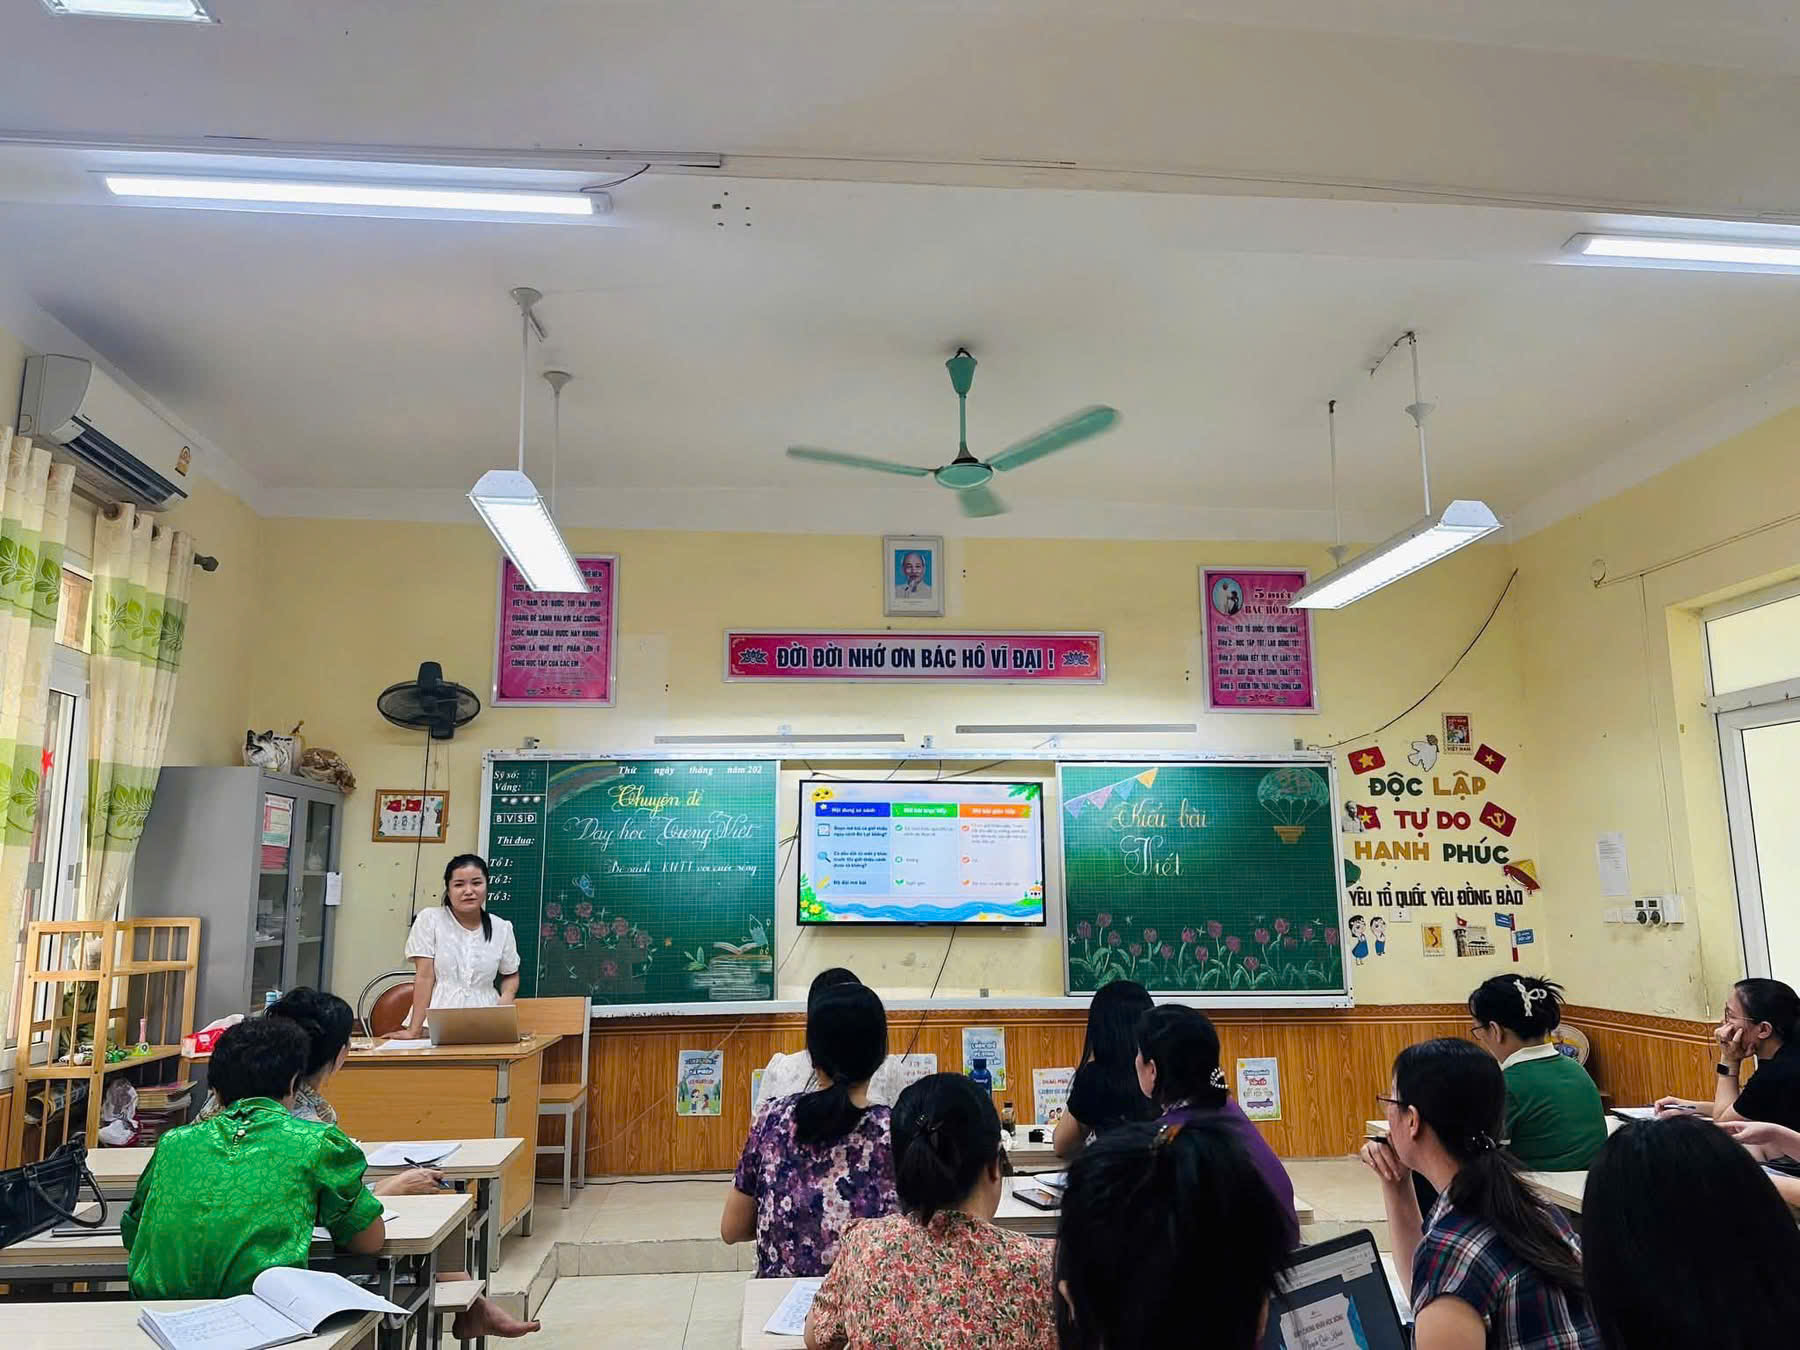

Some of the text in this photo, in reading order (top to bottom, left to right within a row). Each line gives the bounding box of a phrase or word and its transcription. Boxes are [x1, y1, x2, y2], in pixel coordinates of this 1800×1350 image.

[1255, 589, 1264, 598] 5
[777, 643, 807, 667] ĐỜI
[813, 643, 843, 667] ĐỜI
[849, 643, 886, 667] NHỚ
[891, 647, 915, 668] ƠN
[921, 645, 956, 668] BÁC
[962, 643, 986, 669] HỒ
[991, 646, 1008, 669] VĨ
[1012, 649, 1042, 673] ĐẠI
[1368, 770, 1486, 802] ĐỘC LẬP
[1394, 807, 1471, 837] TỰ DO
[1354, 836, 1510, 867] HẠNH PHÚC
[1349, 881, 1523, 908] YÊU TỔ QUỐC YÊU ĐỒNG BÀO
